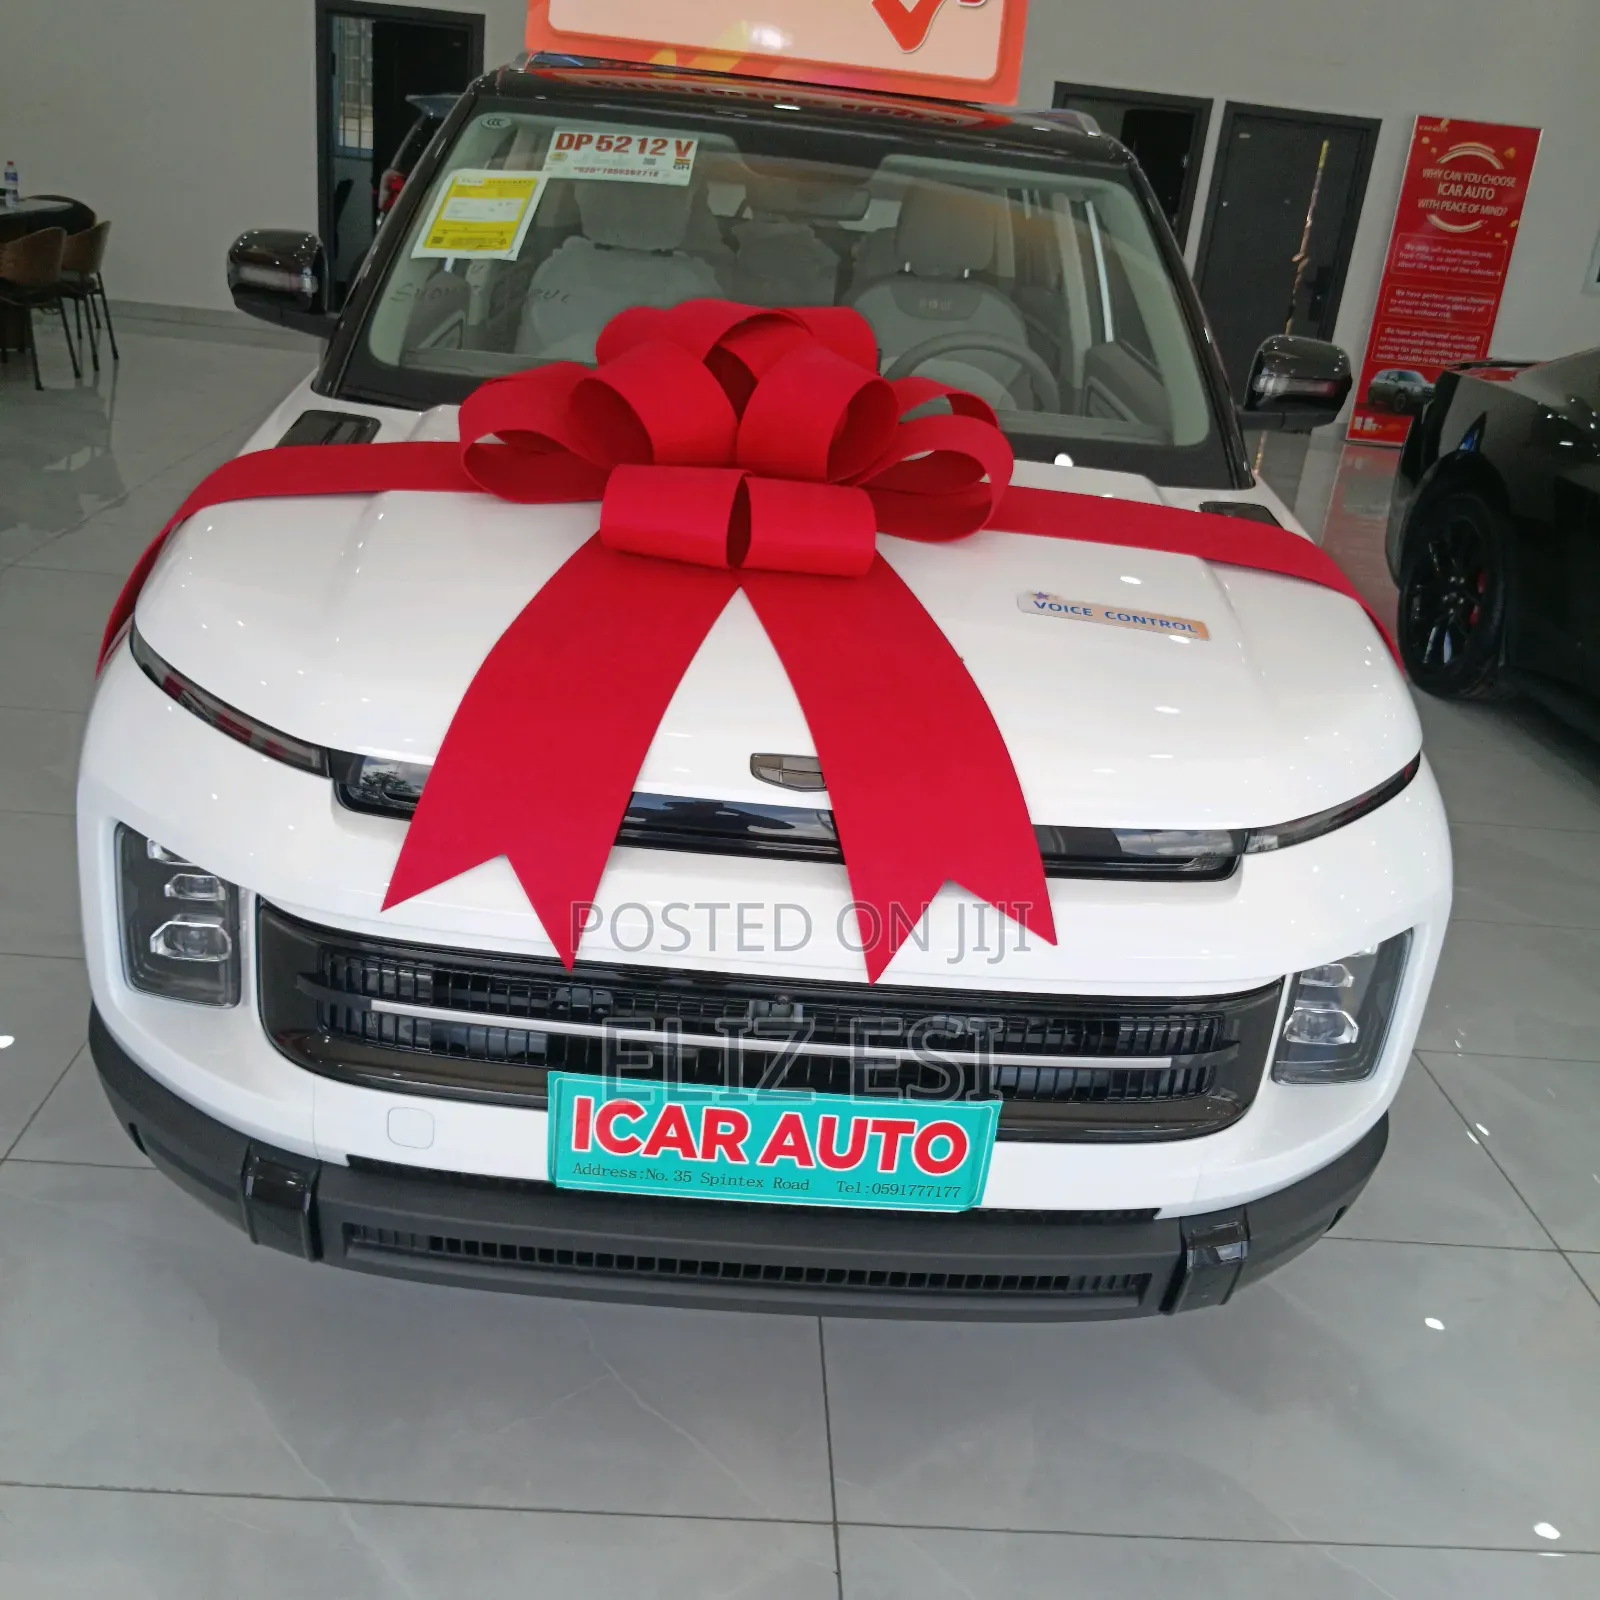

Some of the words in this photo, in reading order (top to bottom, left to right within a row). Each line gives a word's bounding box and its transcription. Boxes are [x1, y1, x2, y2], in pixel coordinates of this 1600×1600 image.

[554, 132, 594, 152] DP
[595, 134, 667, 157] 5212
[674, 139, 694, 158] V
[1422, 168, 1442, 180] WHY
[1443, 170, 1462, 182] CAN
[1463, 172, 1482, 184] YOU
[1482, 174, 1516, 188] CHOOSE
[1438, 183, 1463, 197] ICAR
[1463, 185, 1495, 200] AUTO
[1417, 198, 1440, 211] WITH
[1440, 201, 1467, 214] PEACE
[1468, 203, 1480, 215] OF
[1480, 204, 1508, 217] MIND?
[1033, 600, 1093, 616] VOICE
[1104, 611, 1198, 633] CONTROL
[571, 1095, 750, 1165] ICAR
[757, 1110, 970, 1177] AUTO
[573, 1162, 669, 1181] Address:No.
[674, 1170, 693, 1184] 35
[701, 1172, 764, 1189] Spintex
[773, 1176, 811, 1191] Road
[836, 1180, 962, 1199] Tel:0591777177
